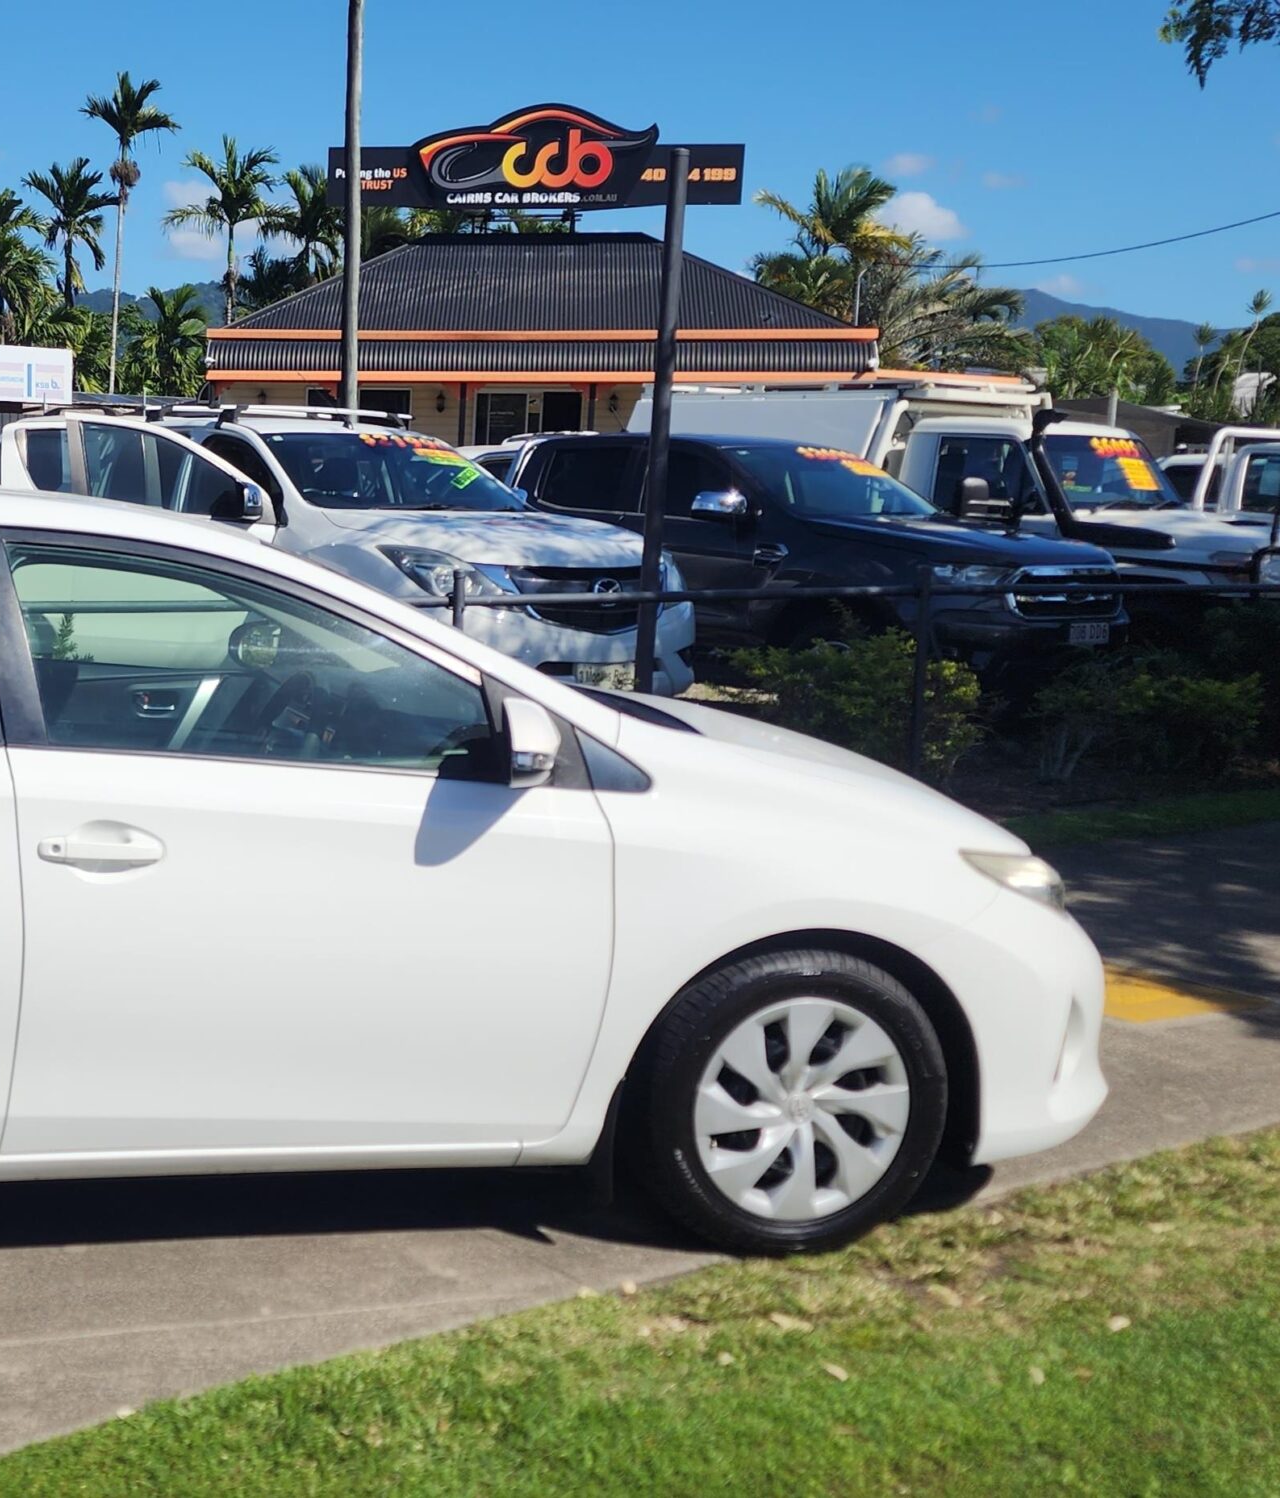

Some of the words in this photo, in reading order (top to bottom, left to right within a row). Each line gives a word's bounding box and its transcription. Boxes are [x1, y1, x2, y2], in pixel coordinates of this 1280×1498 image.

[374, 168, 391, 178] the
[392, 168, 408, 178] US
[641, 168, 666, 181] 40
[361, 180, 393, 190] TRUST
[446, 192, 492, 205] CAIRNS
[494, 192, 519, 204] CAR
